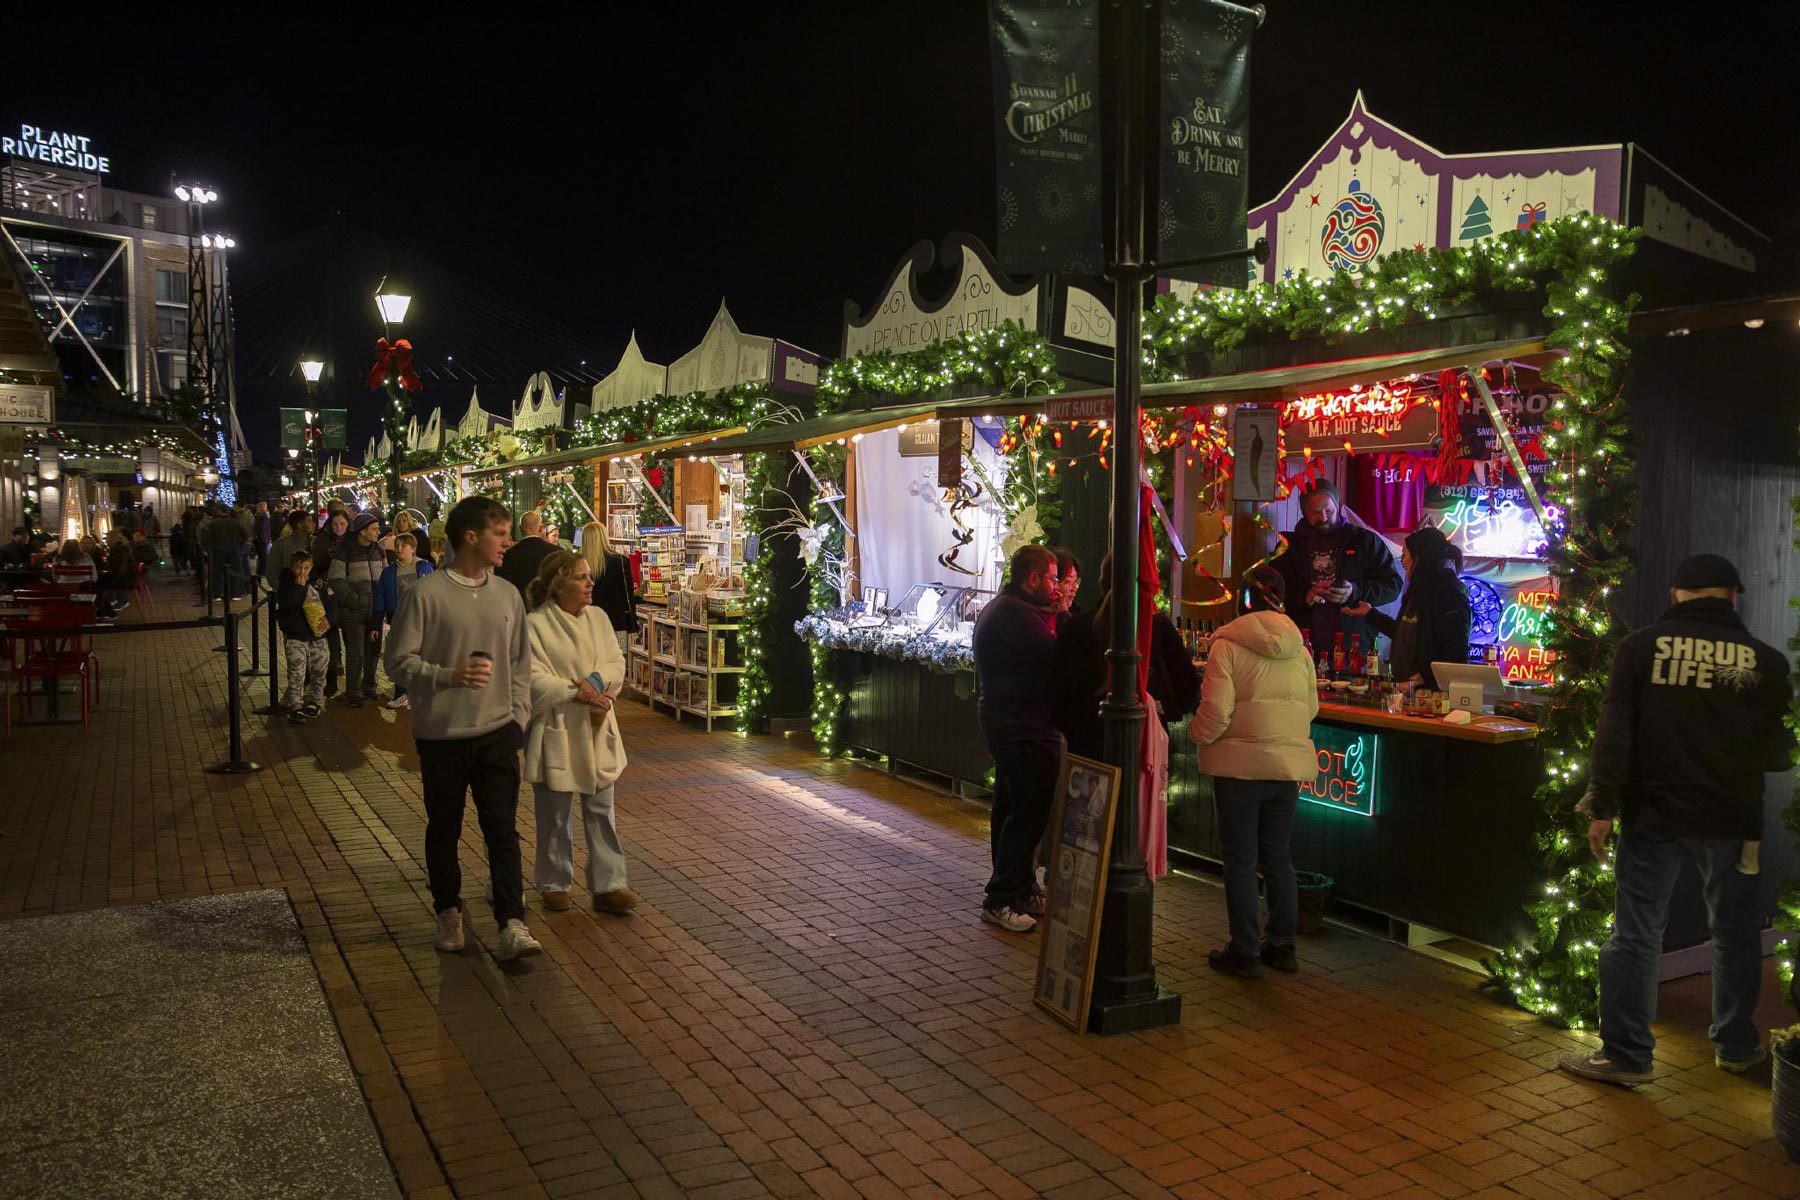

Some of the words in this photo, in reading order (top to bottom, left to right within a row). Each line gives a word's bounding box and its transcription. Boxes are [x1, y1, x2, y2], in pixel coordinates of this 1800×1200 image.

[1010, 82, 1057, 100] SAVANNAH
[1005, 91, 1093, 143] CHRISTMAS
[1171, 116, 1222, 148] DRINK
[21, 124, 91, 152] PLANT
[2, 136, 110, 173] RIVERSIDE
[1177, 149, 1191, 166] BE
[1193, 145, 1240, 176] MERRY
[873, 322, 918, 350] PEACE
[920, 317, 943, 346] ON
[944, 307, 999, 340] EARTH
[0, 406, 44, 419] HOUSE
[1050, 401, 1071, 417] HOT
[1072, 398, 1107, 417] SAUCE
[1335, 418, 1358, 436] HOT
[1361, 414, 1402, 434] SAUCE
[1654, 635, 1757, 670] SHRUB
[1651, 659, 1715, 690] LIFE
[1316, 749, 1345, 776] OT
[1297, 776, 1358, 806] AUCE
